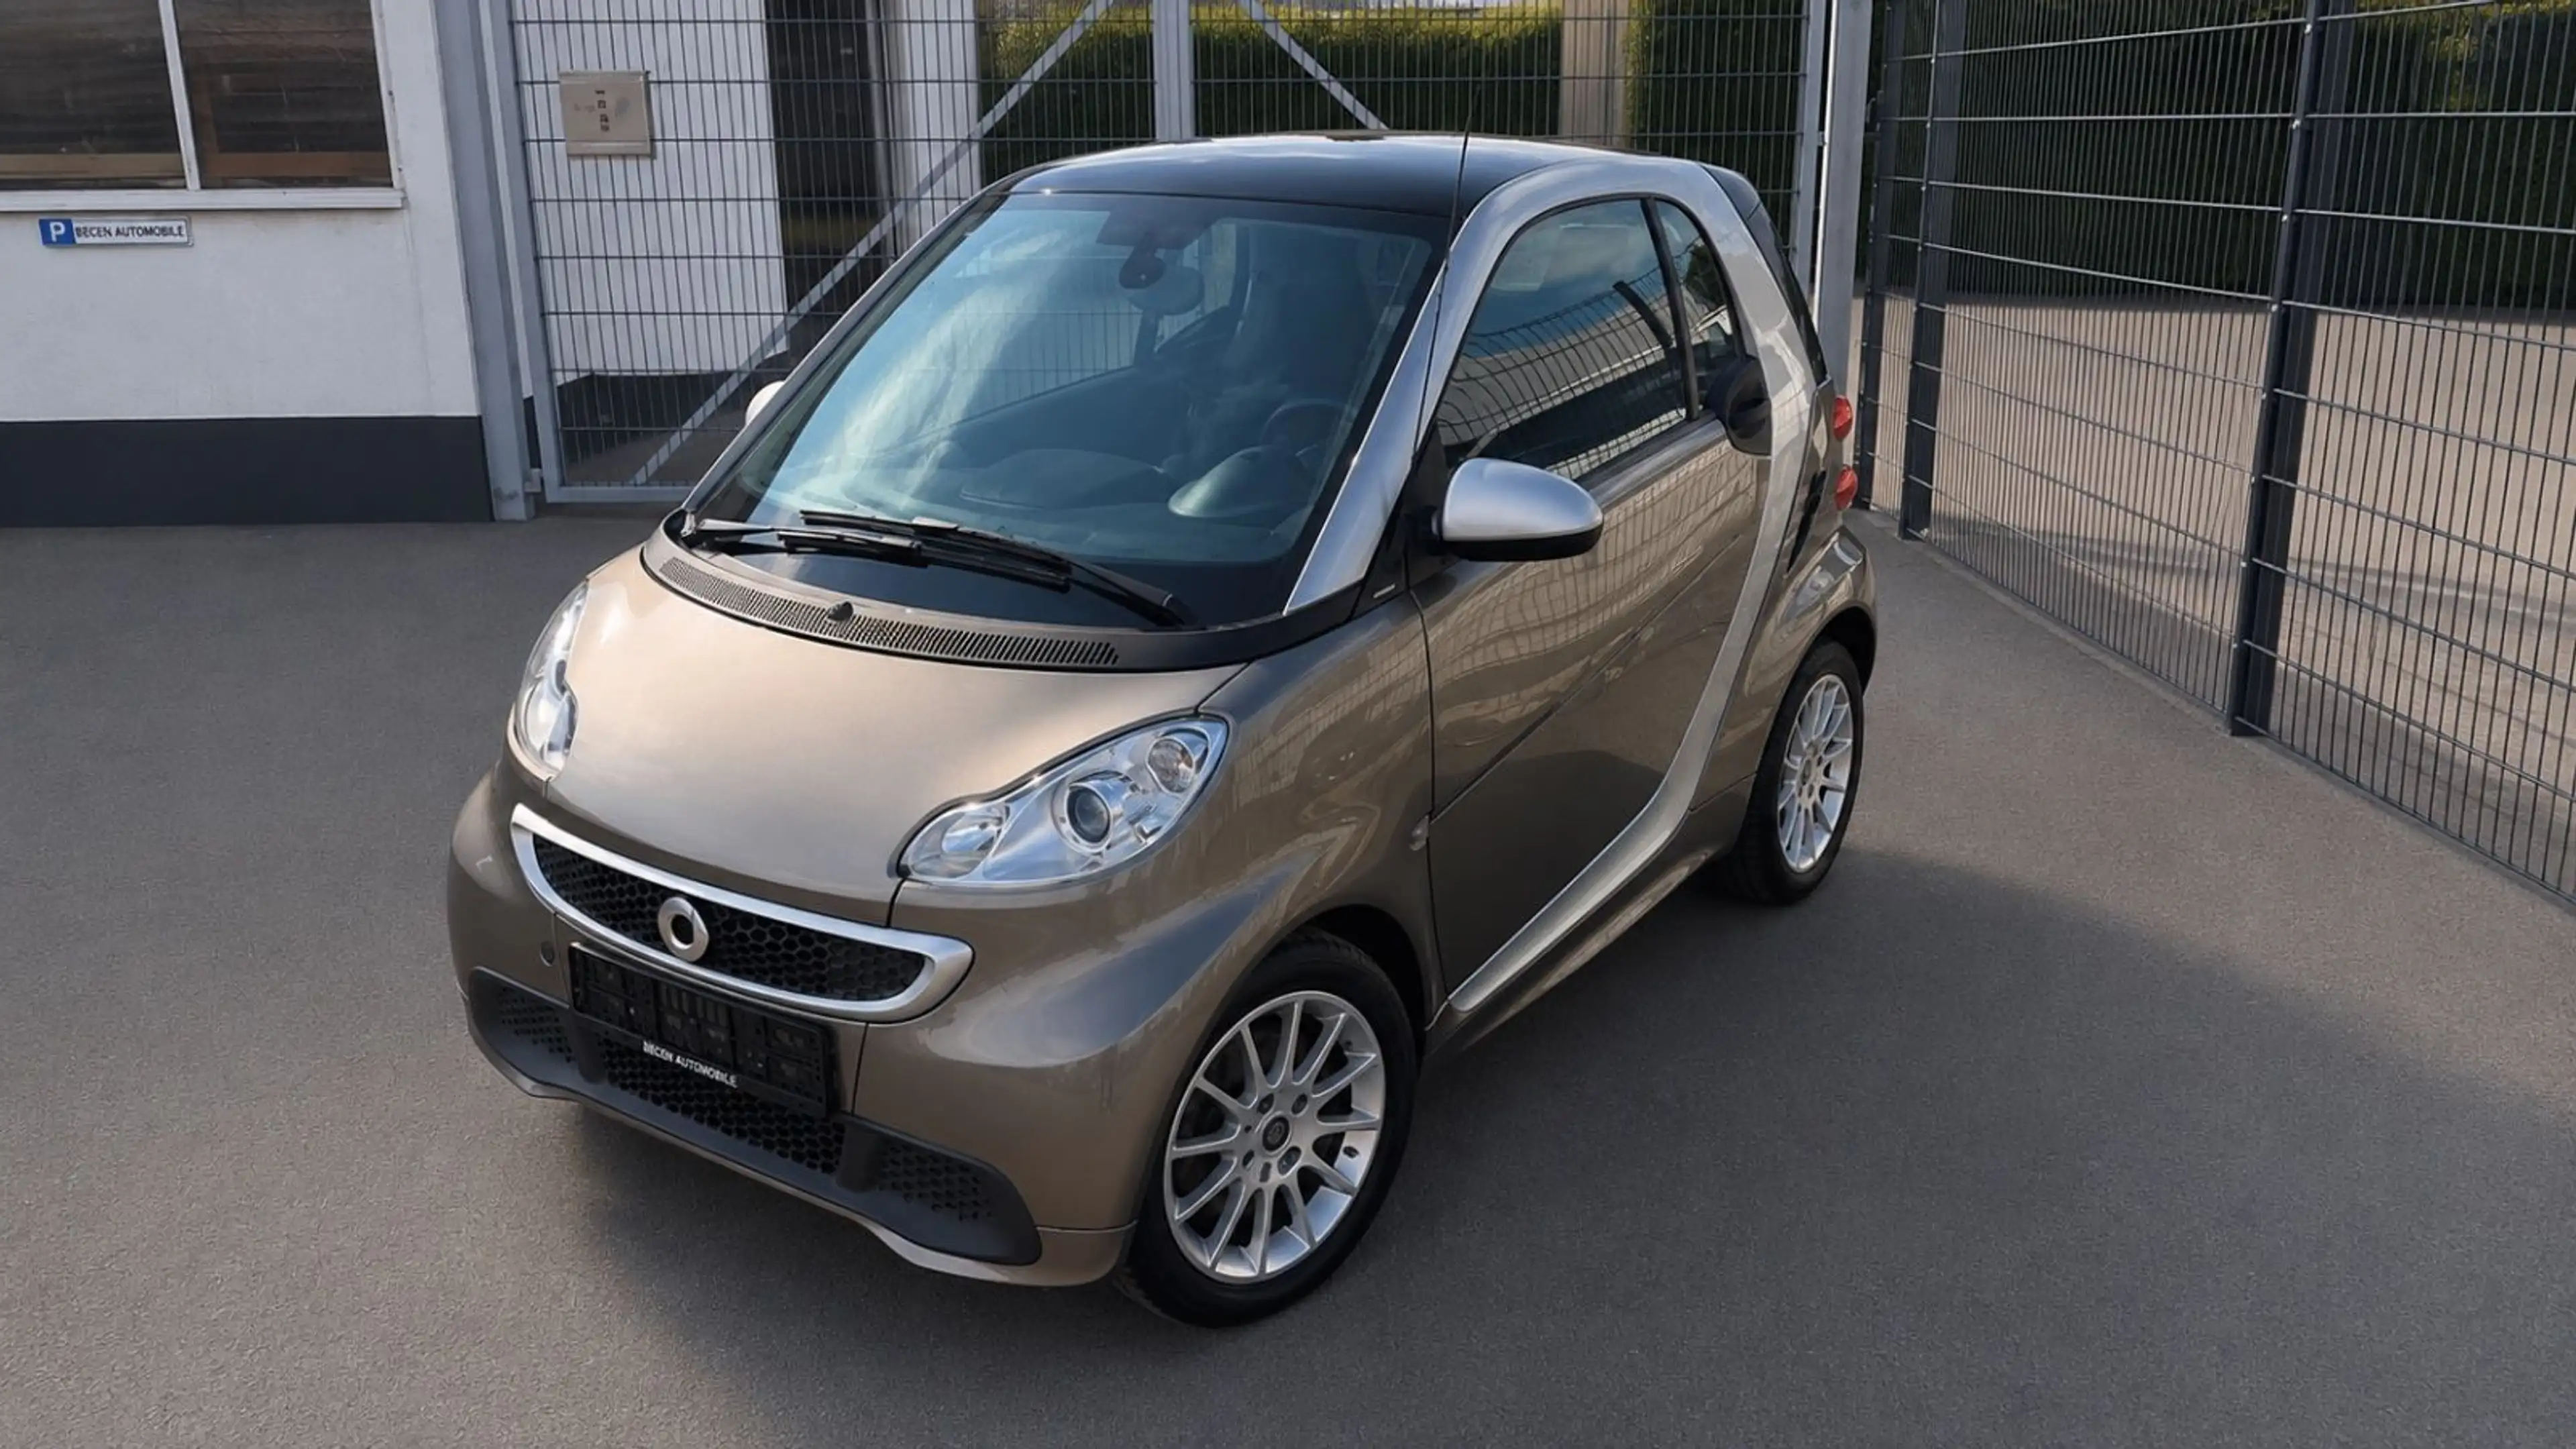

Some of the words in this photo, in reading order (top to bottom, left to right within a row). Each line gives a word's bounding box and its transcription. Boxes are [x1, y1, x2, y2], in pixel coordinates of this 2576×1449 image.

[50, 221, 65, 243] P
[115, 225, 184, 237] AUTOMOBILE
[676, 1055, 738, 1088] AUTOMOBILE
